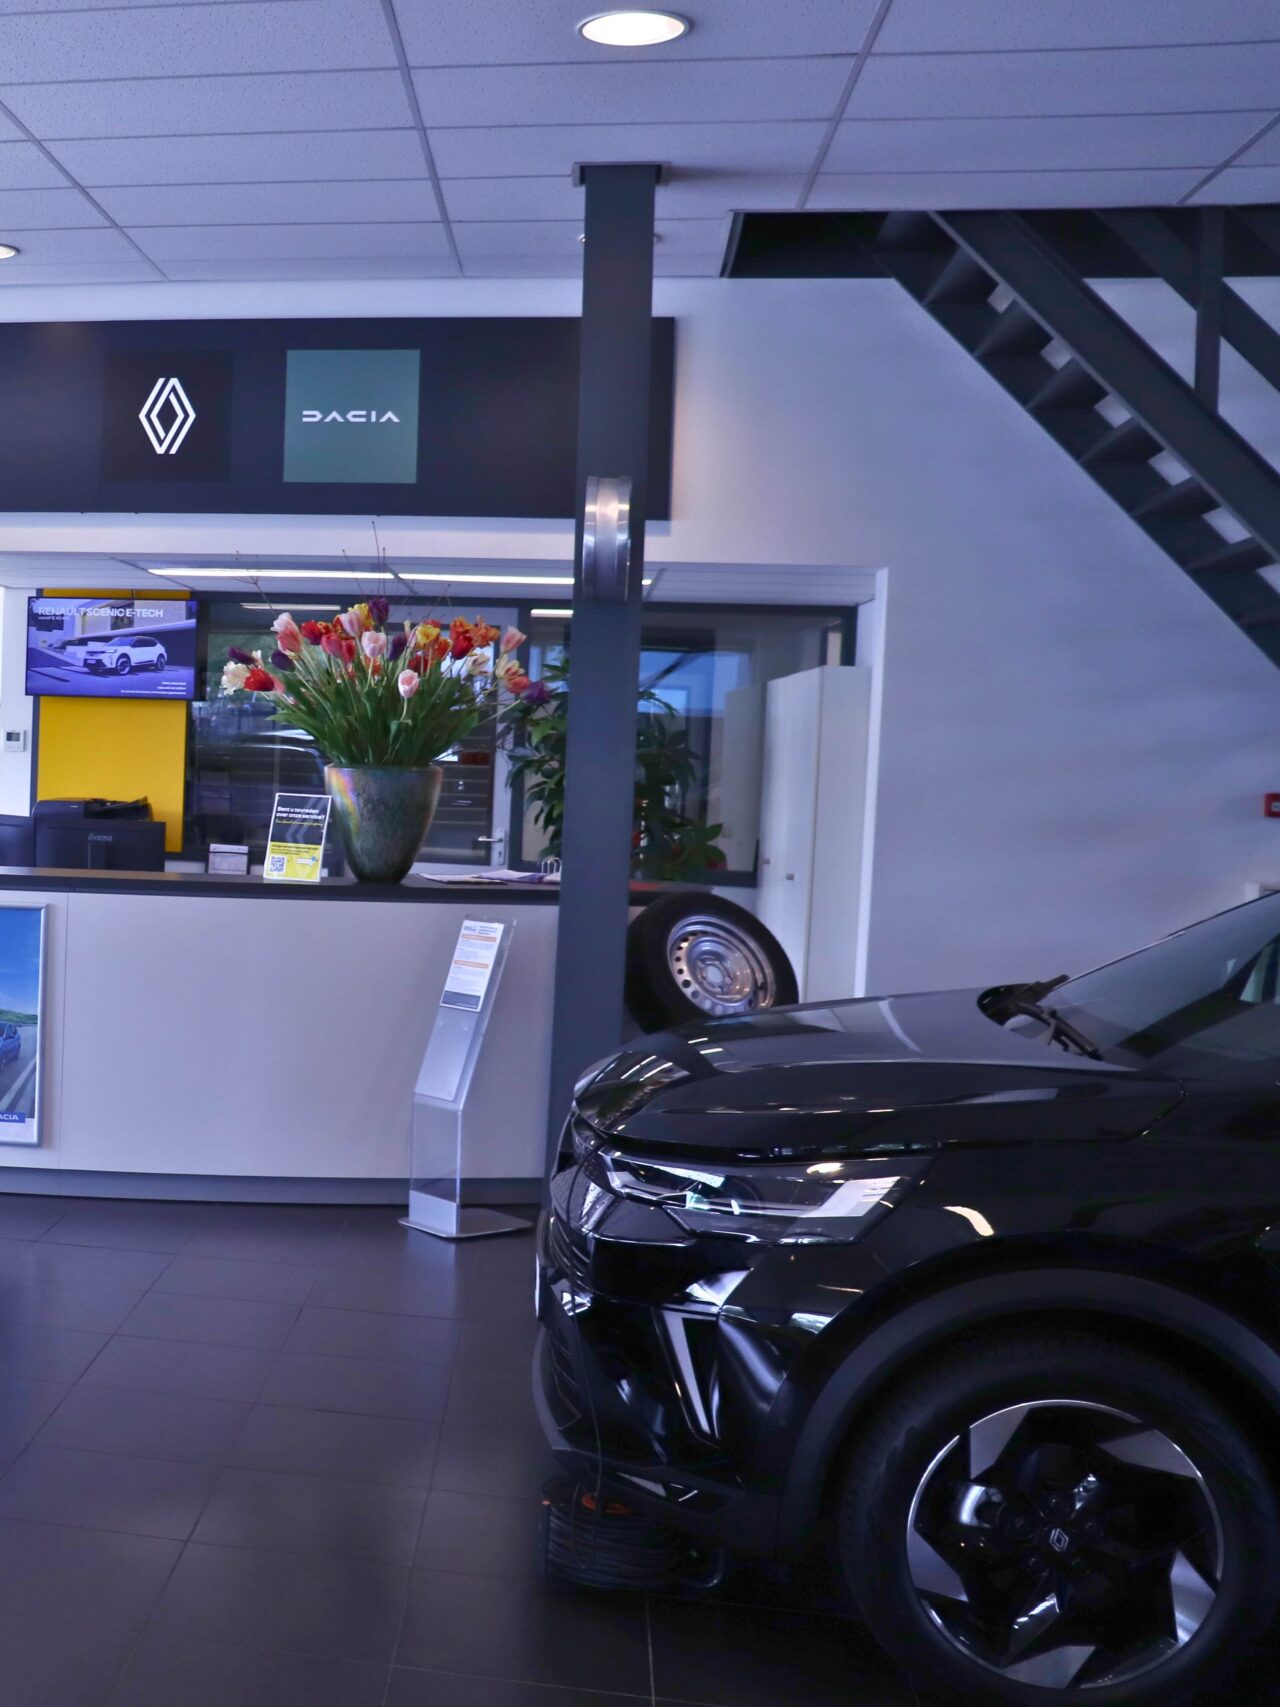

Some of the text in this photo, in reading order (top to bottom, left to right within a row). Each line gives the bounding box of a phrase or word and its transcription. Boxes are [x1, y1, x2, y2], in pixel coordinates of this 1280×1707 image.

[301, 410, 401, 422] DACIA
[38, 607, 164, 618] RENAULT SCENIC E-TECH
